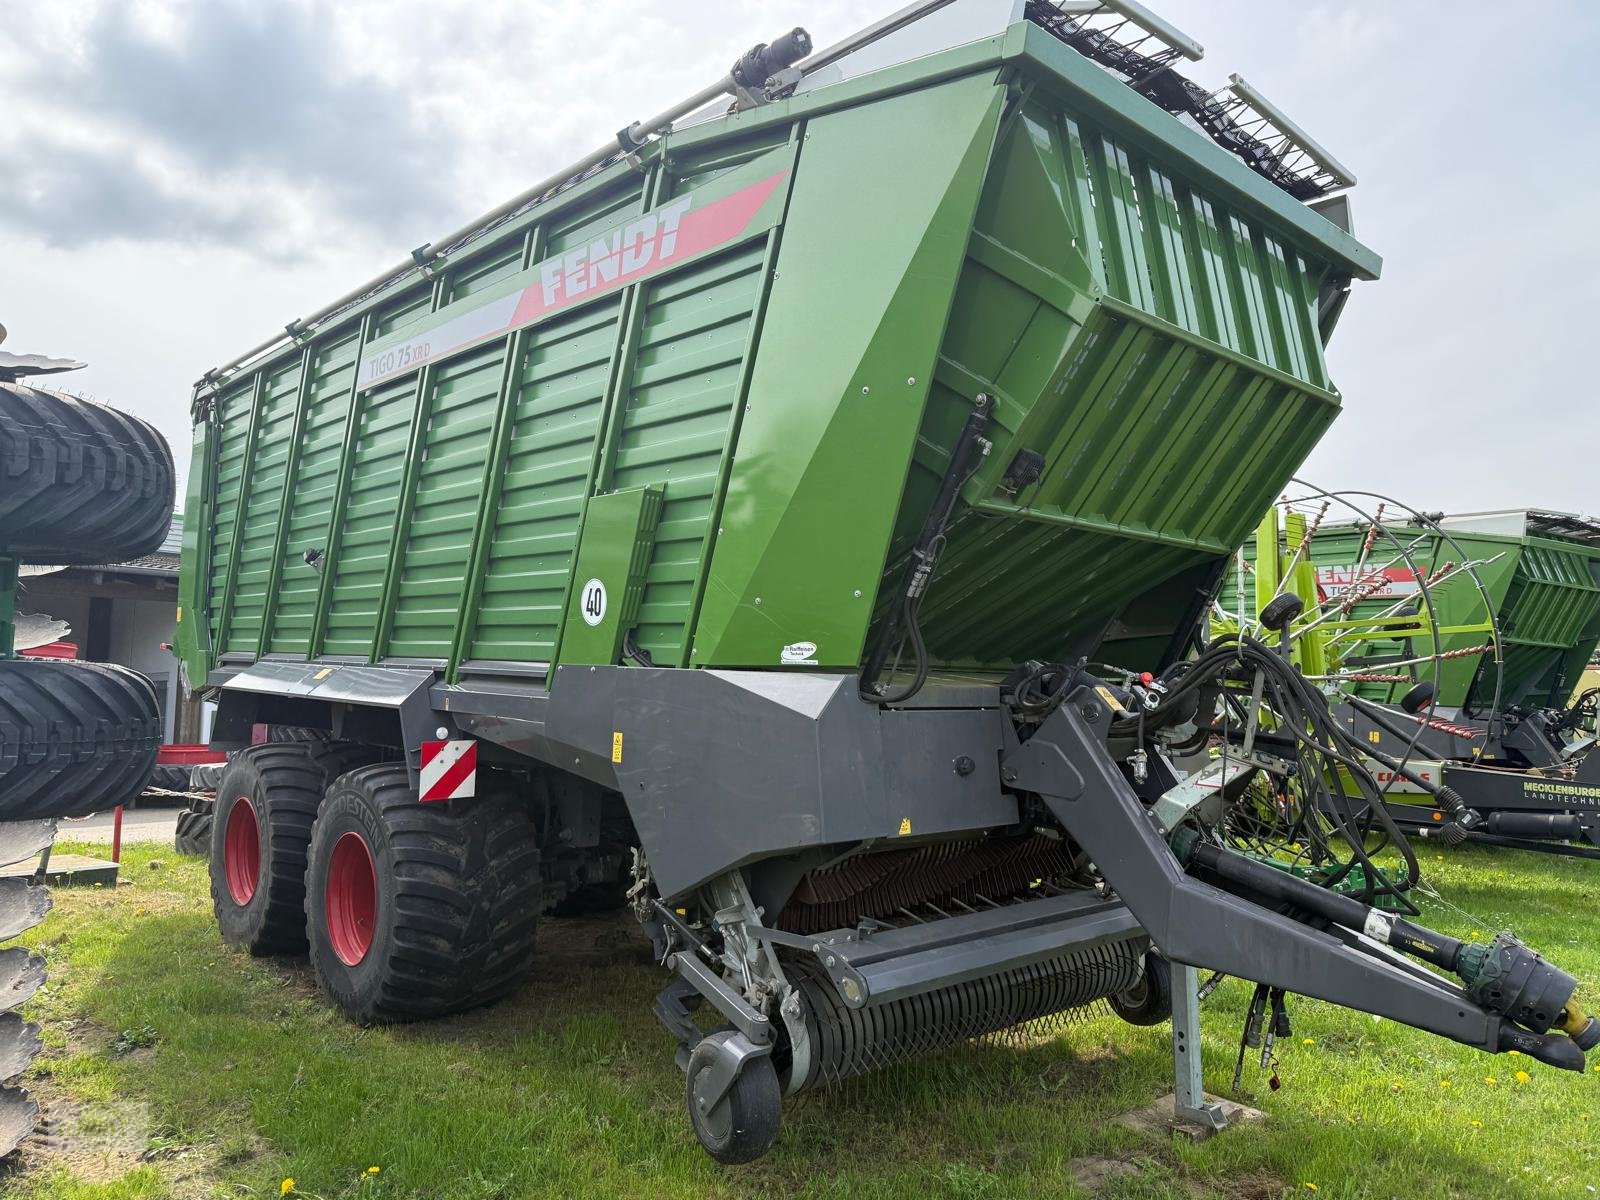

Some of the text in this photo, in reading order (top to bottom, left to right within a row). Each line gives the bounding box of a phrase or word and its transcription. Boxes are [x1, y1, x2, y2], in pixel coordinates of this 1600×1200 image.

[541, 194, 693, 307] FENDT
[370, 352, 394, 379] TIGO
[398, 344, 411, 369] 75
[586, 588, 602, 617] 40
